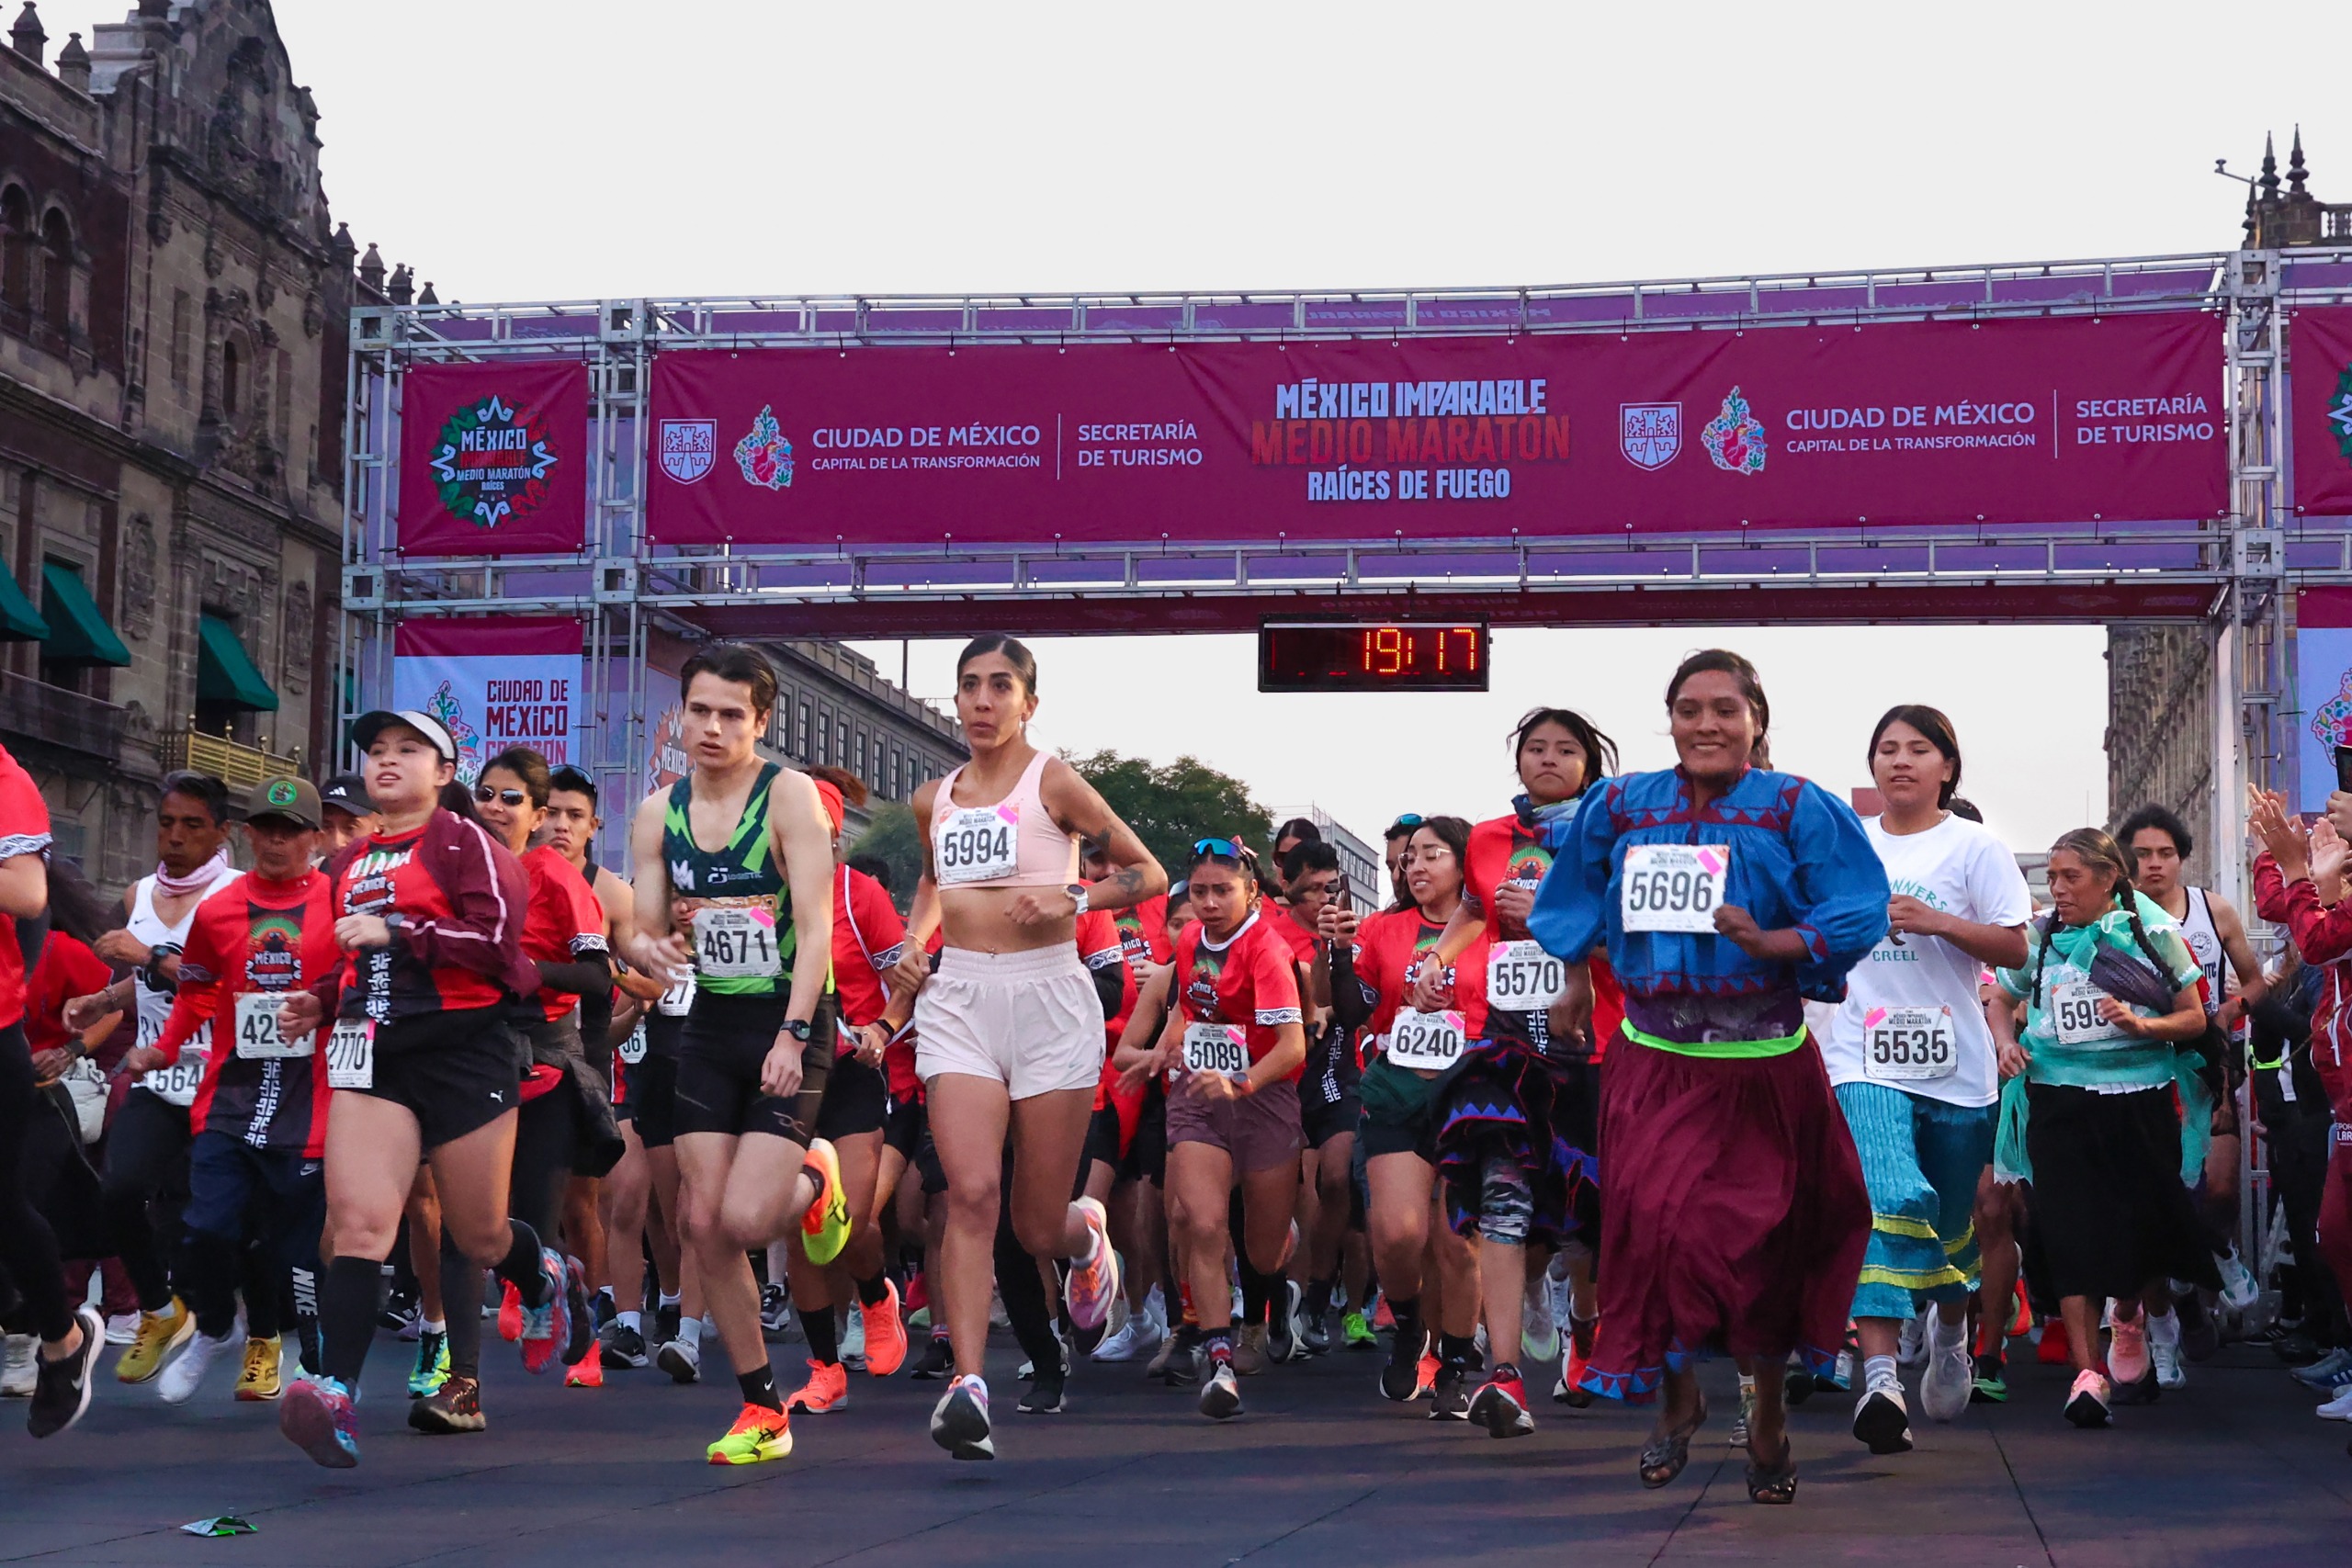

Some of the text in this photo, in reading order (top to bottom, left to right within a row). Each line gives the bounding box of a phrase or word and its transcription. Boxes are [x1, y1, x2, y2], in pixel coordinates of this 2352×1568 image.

[1276, 378, 1547, 419] MÉXICO IMPARABLE
[1786, 399, 2035, 430] CIUDAD DE MÉXICO
[2075, 392, 2208, 418] SECRETARÍA
[461, 426, 526, 451] MÉXICO
[812, 421, 1041, 448] CIUDAD DE MÉXICO
[1078, 419, 1198, 442] SECRETARÍA
[1251, 407, 1571, 465] MEDIO MARATÓN
[1786, 430, 2036, 453] CAPITAL DE LA TRANSFORMACIÓN
[2076, 423, 2214, 445] DE TURISMO
[457, 465, 531, 481] MEDIO MARATÓN
[812, 453, 1040, 470] CAPITAL DE LA TRANSFORMACIÓN
[1078, 447, 1203, 467] DE TURISMO
[1307, 463, 1510, 501] RAÍCES DE FUEGO
[1365, 628, 1476, 673] 19:17
[550, 679, 569, 701] DE
[662, 741, 687, 777] MÉXICO
[944, 826, 1009, 866] 5994
[1630, 871, 1713, 912] 5696
[1891, 877, 1948, 911] NNERS
[704, 930, 769, 964] 4671
[1872, 950, 1919, 962] CREEL
[1496, 961, 1559, 996] 5570
[2061, 998, 2109, 1031] 595
[329, 1032, 367, 1070] 2770
[1189, 1040, 1243, 1072] 5089
[1396, 1025, 1457, 1057] 6240
[1874, 1030, 1948, 1064] 5535
[154, 1065, 200, 1093] 564
[292, 1266, 318, 1316] NIKE
